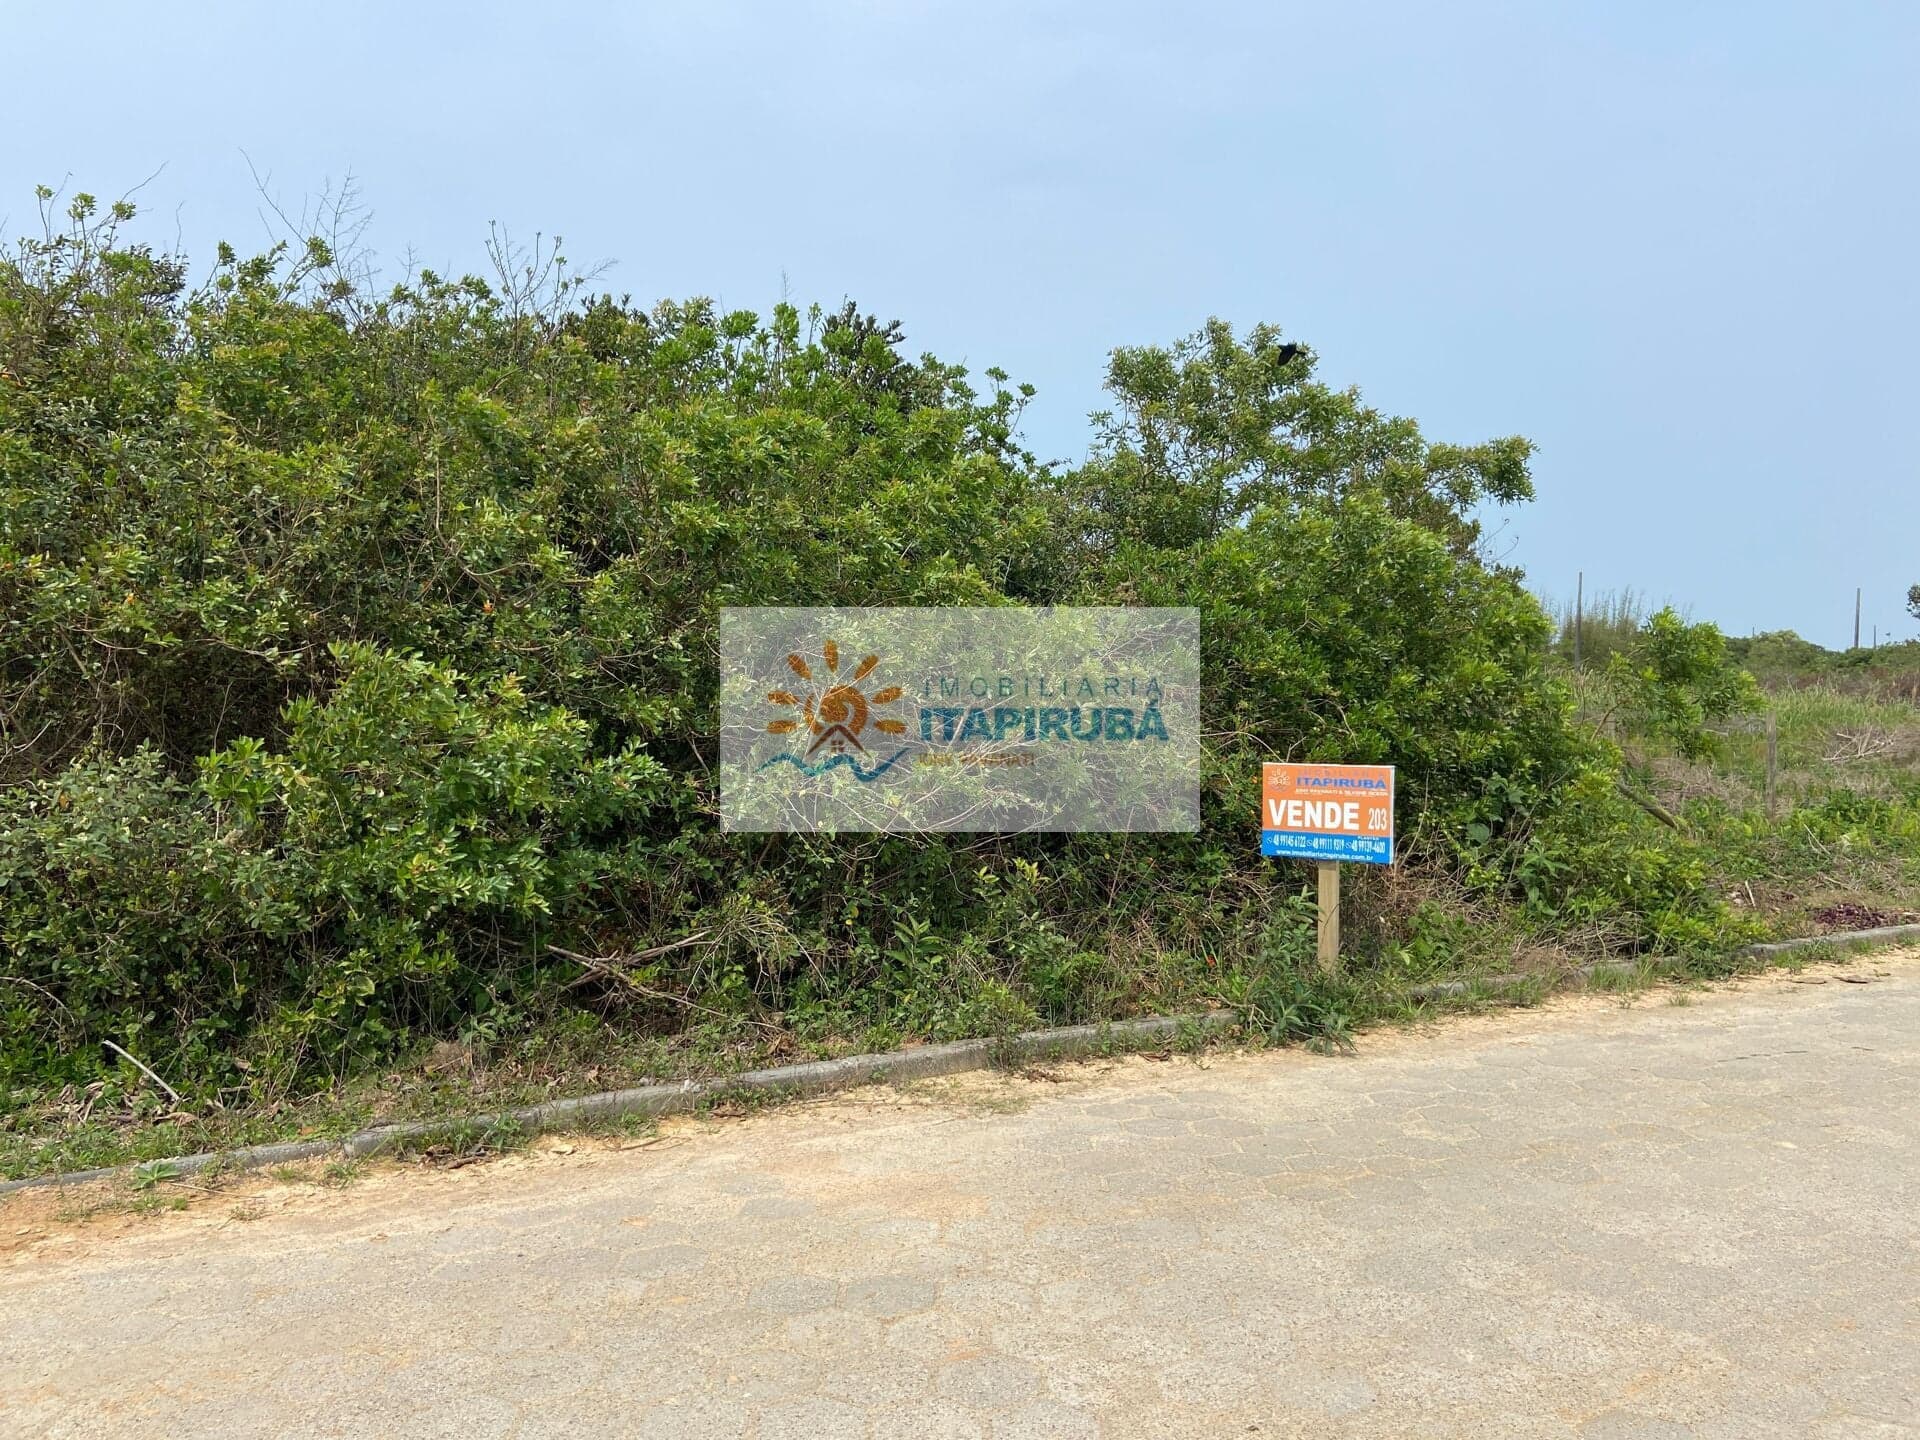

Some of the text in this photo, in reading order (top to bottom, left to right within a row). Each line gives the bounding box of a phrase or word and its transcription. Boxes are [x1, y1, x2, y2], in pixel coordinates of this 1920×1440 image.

[1296, 776, 1386, 789] ITAPIRUBÁ
[1268, 799, 1387, 830] VENDE 203
